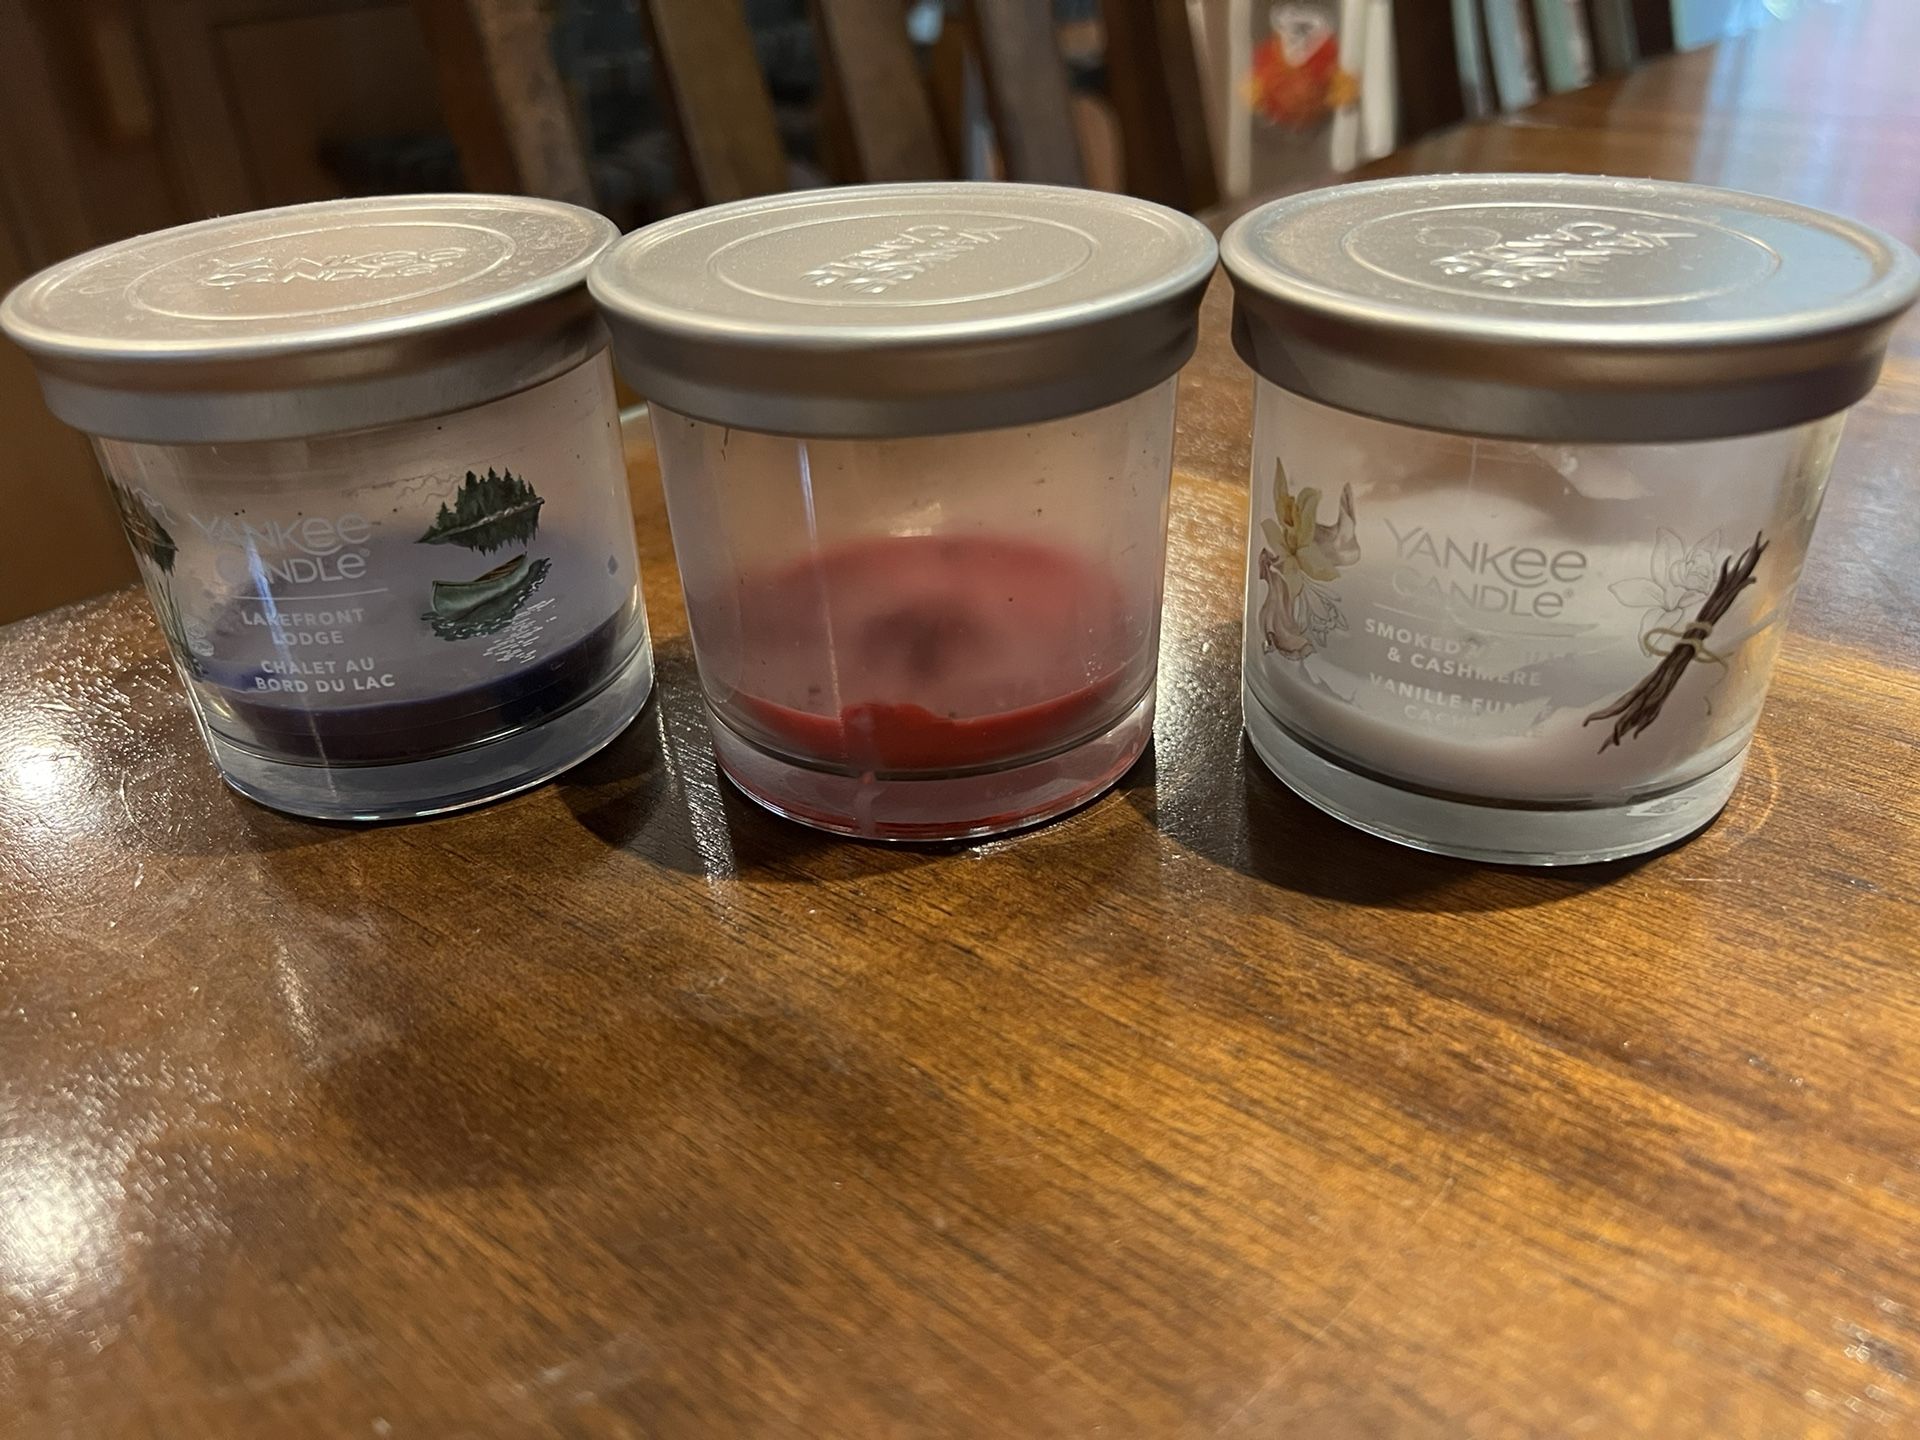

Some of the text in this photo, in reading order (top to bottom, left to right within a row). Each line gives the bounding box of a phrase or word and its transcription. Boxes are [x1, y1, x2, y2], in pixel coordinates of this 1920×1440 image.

[271, 631, 345, 646] LODGE
[1364, 618, 1461, 655] SMOKED
[1387, 646, 1401, 664] &
[260, 656, 376, 675] CHALET AU
[254, 673, 396, 693] BORD DU LAC
[1369, 672, 1462, 710] VANILLE
